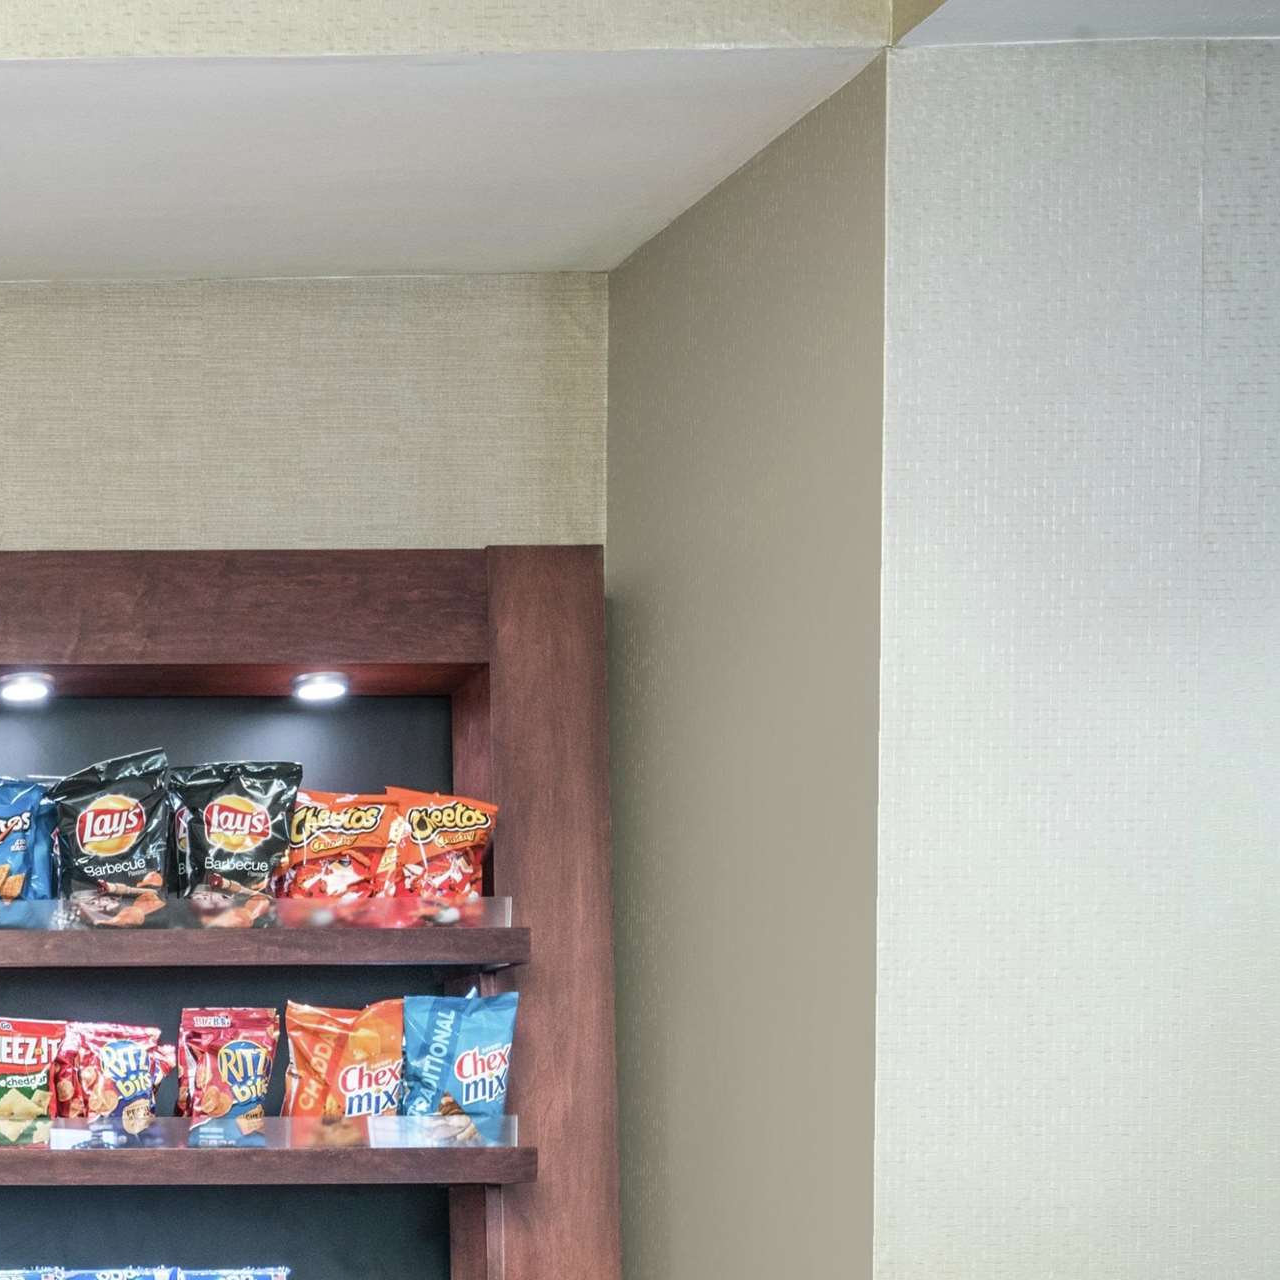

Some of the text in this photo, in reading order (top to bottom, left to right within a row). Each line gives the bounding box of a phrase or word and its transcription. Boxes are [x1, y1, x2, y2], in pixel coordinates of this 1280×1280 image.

[82, 808, 142, 844] Lay's
[209, 803, 267, 835] Lay's
[291, 806, 381, 845] Cheetos
[409, 802, 489, 841] Cheetos
[85, 858, 146, 877] Barbecue
[204, 857, 269, 872] Barbecue
[101, 1046, 151, 1077] RITZ
[220, 1048, 268, 1078] RITZ
[456, 1045, 512, 1076] Chex
[232, 1075, 268, 1101] bits
[340, 1061, 403, 1091] Chex
[464, 1073, 507, 1101] mix
[346, 1089, 399, 1115] mix
